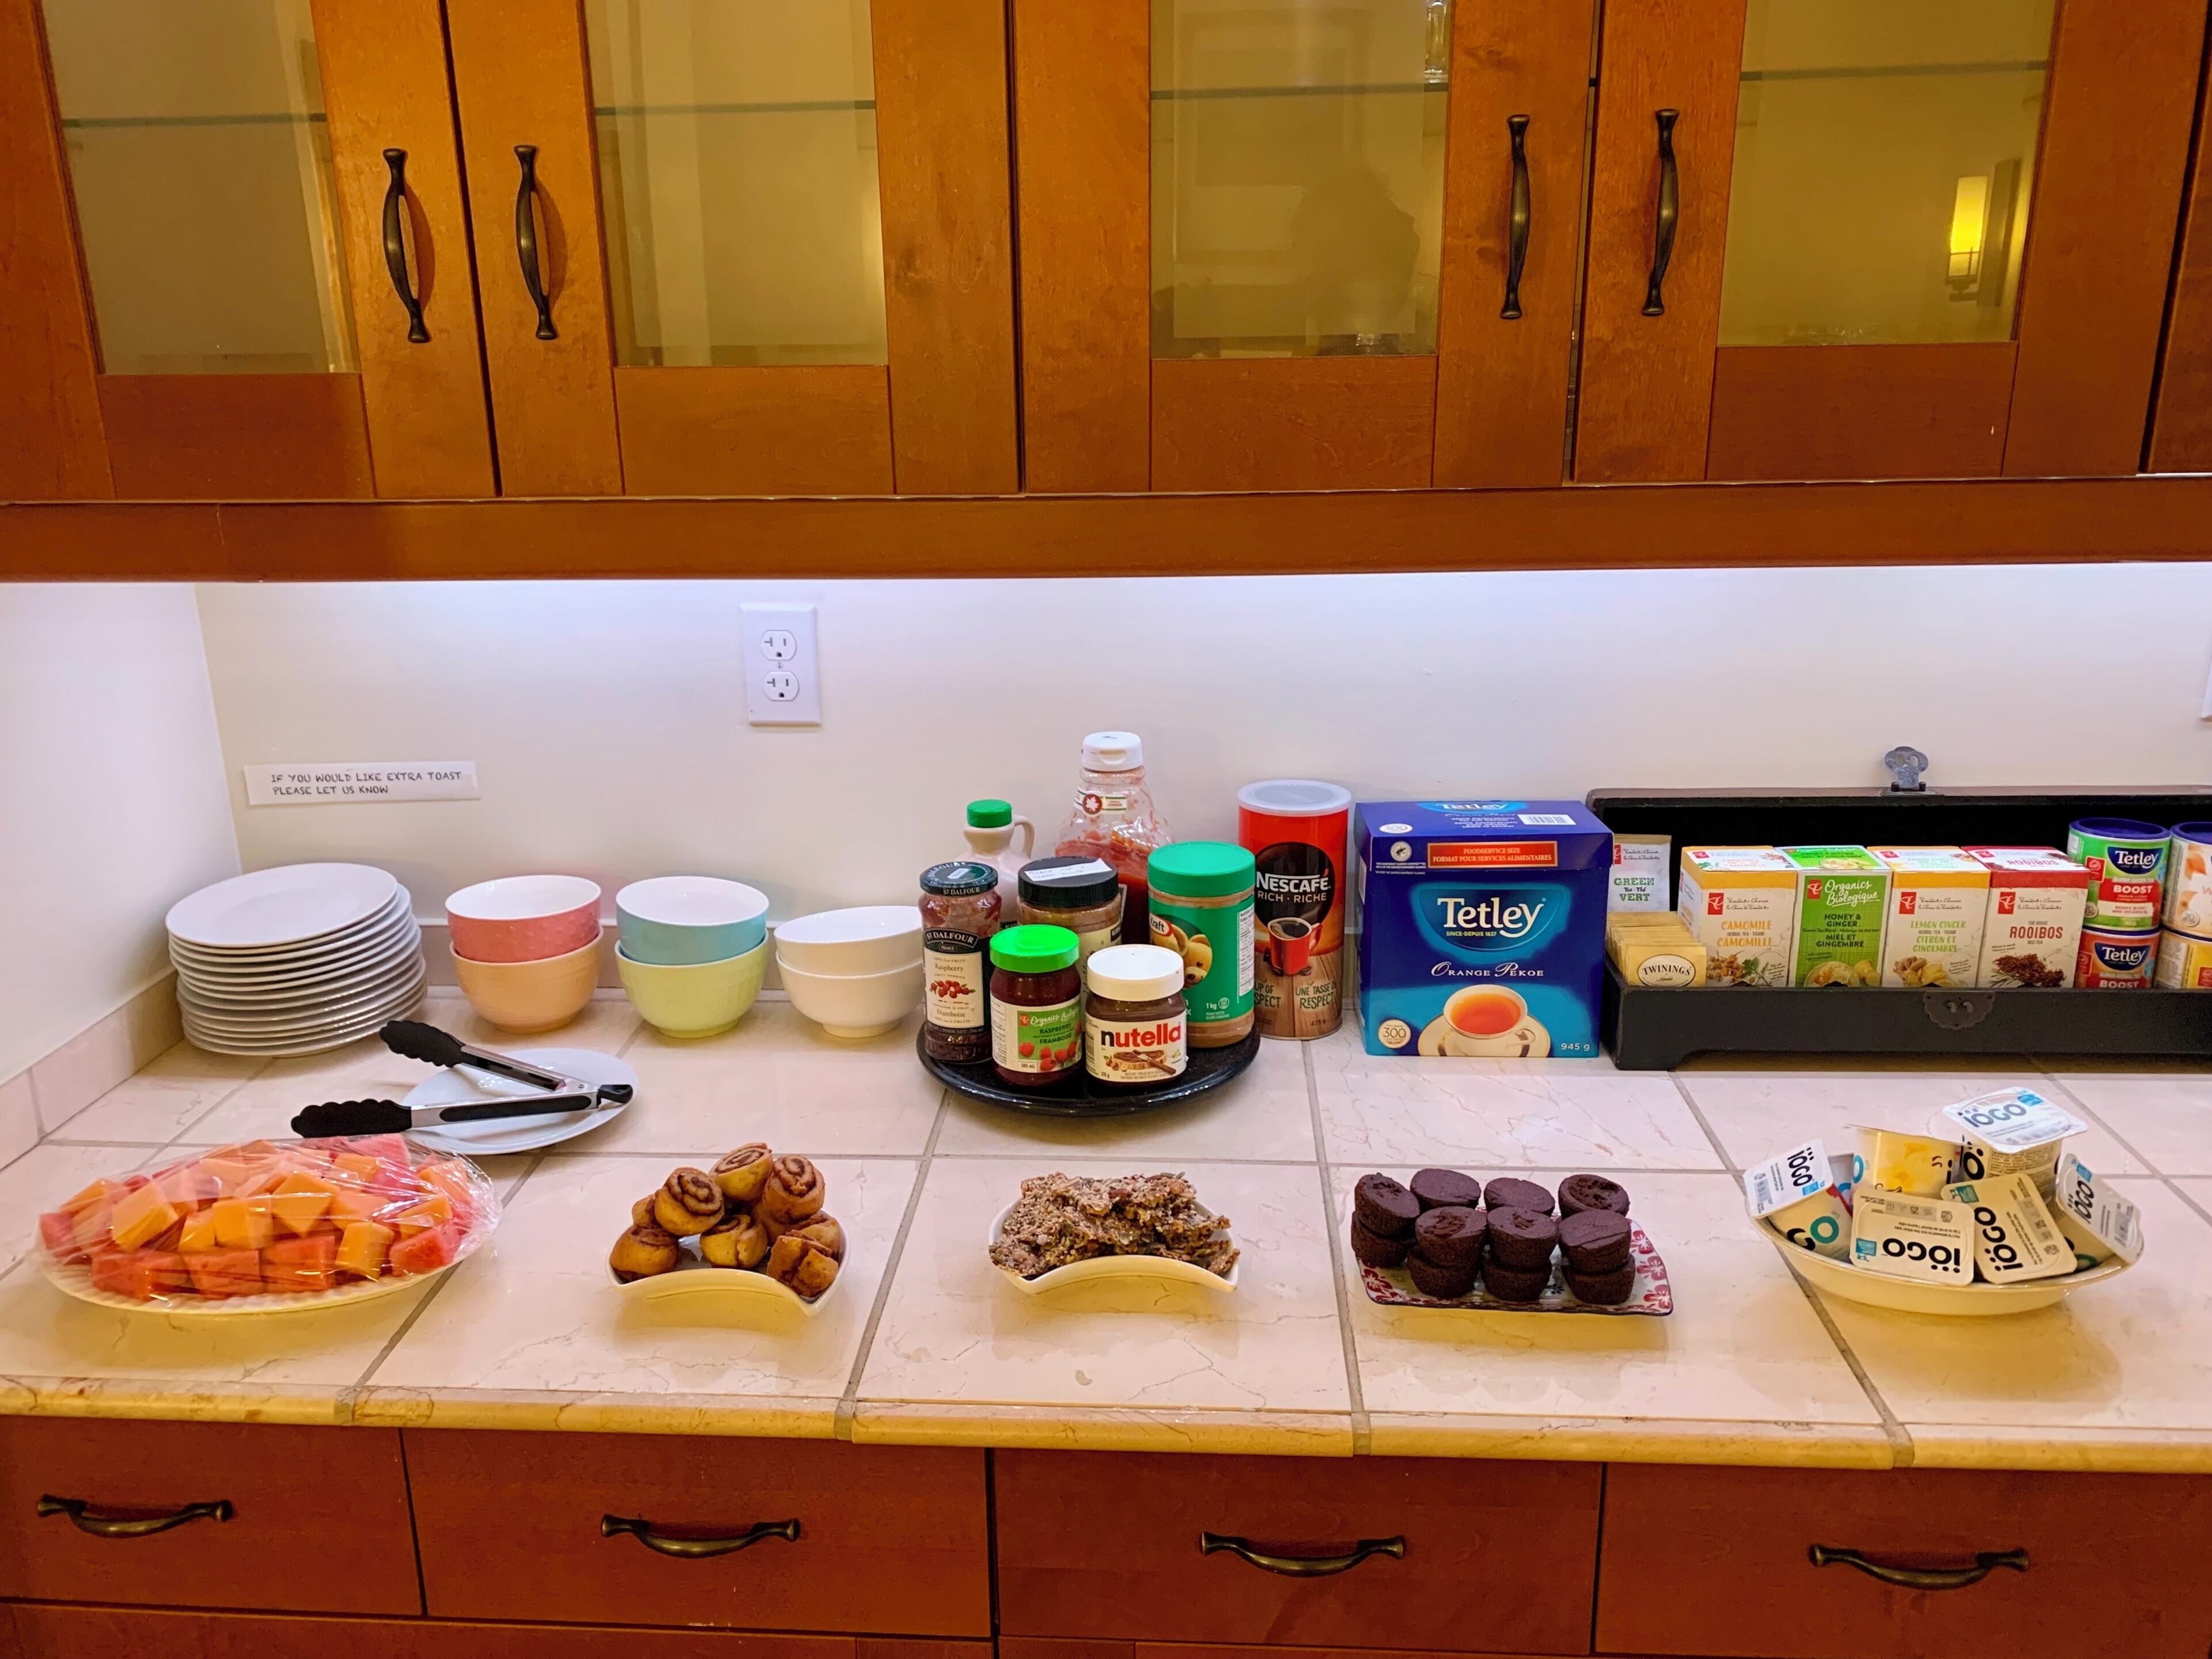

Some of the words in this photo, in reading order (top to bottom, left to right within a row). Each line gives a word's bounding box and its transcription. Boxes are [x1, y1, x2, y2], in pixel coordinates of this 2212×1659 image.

[271, 775, 283, 783] IF
[287, 774, 311, 783] YOU
[316, 773, 351, 782] WOULD
[356, 772, 381, 782] LIKE
[387, 772, 423, 781] EXTRA
[427, 771, 461, 781] TOAST
[272, 786, 312, 795] PLEASE
[316, 786, 336, 794] LET
[342, 785, 355, 794] US
[359, 785, 388, 794] KNOW
[1435, 803, 1509, 811] Tetley
[2115, 850, 2159, 869] Tetley
[1256, 869, 1329, 893] NESCAFÉ
[950, 887, 980, 895] DALFOUR
[1825, 880, 1873, 896] Organics
[2113, 884, 2153, 894] BOOST
[1258, 891, 1283, 902] RICH
[1294, 892, 1327, 903] RICHE
[1619, 893, 1650, 902] VERT
[1826, 892, 1878, 907] Biologique
[1437, 897, 1544, 938] Tetley
[1150, 918, 1164, 932] Kraft
[1721, 921, 1772, 930] CAMOMILE
[1910, 921, 1937, 929] LEMON
[933, 931, 974, 944] DALFOUR
[2009, 926, 2063, 939] ROOIBOS
[1717, 937, 1773, 947] CAMOMILLE
[1913, 945, 1957, 953] GINGEMBRE
[2102, 947, 2146, 965] Tetley
[934, 963, 963, 972] Raspberry
[1431, 961, 1490, 976] ORANGE
[1494, 962, 1544, 977] PEKOE
[1642, 965, 1692, 976] TWININGS
[1254, 981, 1264, 991] UP
[1265, 984, 1274, 994] OF
[1296, 987, 1309, 996] UNE
[1313, 983, 1330, 995] TASSE
[2100, 980, 2139, 988] BOOST
[1210, 1002, 1217, 1010] kg
[1254, 993, 1281, 1008] SPECT
[1300, 991, 1335, 1009] RESPECT
[937, 1009, 966, 1017] Framboise
[1031, 1014, 1059, 1027] Organics
[1039, 1022, 1071, 1034] RASPBERRY
[1383, 1027, 1406, 1037] 300
[1039, 1032, 1072, 1044] FRAMBOISE
[1101, 1023, 1181, 1047] nutella
